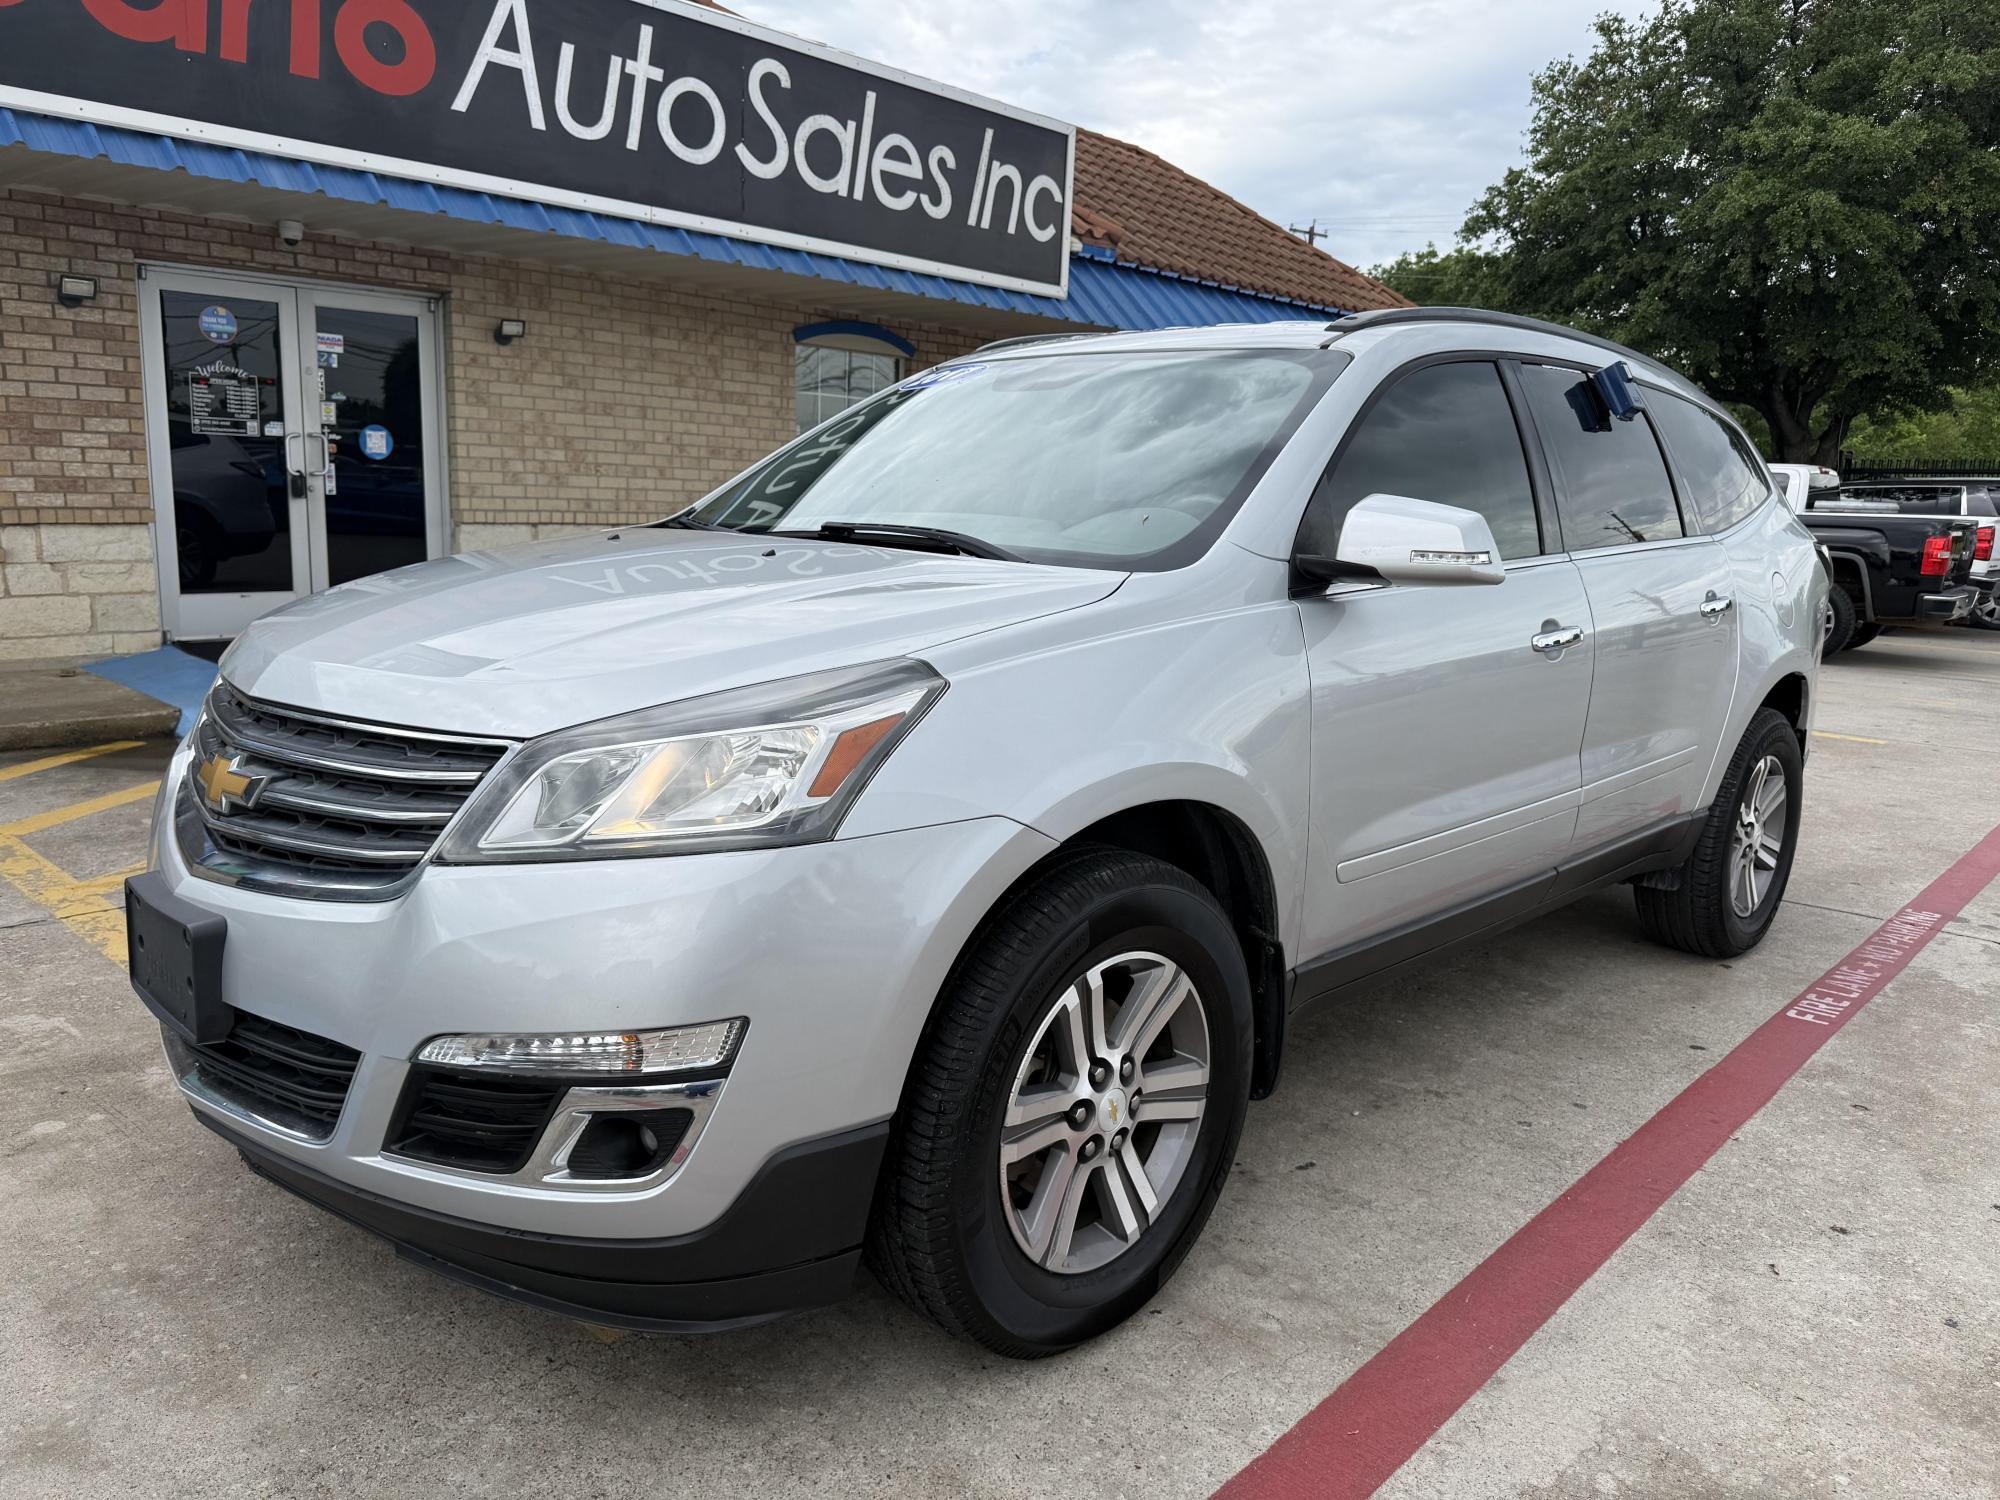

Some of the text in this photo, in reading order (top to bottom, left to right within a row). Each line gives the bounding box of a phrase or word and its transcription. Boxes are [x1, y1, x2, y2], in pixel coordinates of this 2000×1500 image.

[450, 0, 726, 165] Auto
[734, 58, 957, 220] Sales
[967, 127, 1063, 243] Inc
[194, 360, 250, 379] Welcome
[1786, 908, 1943, 1025] FIRE LANE NO PARKING
